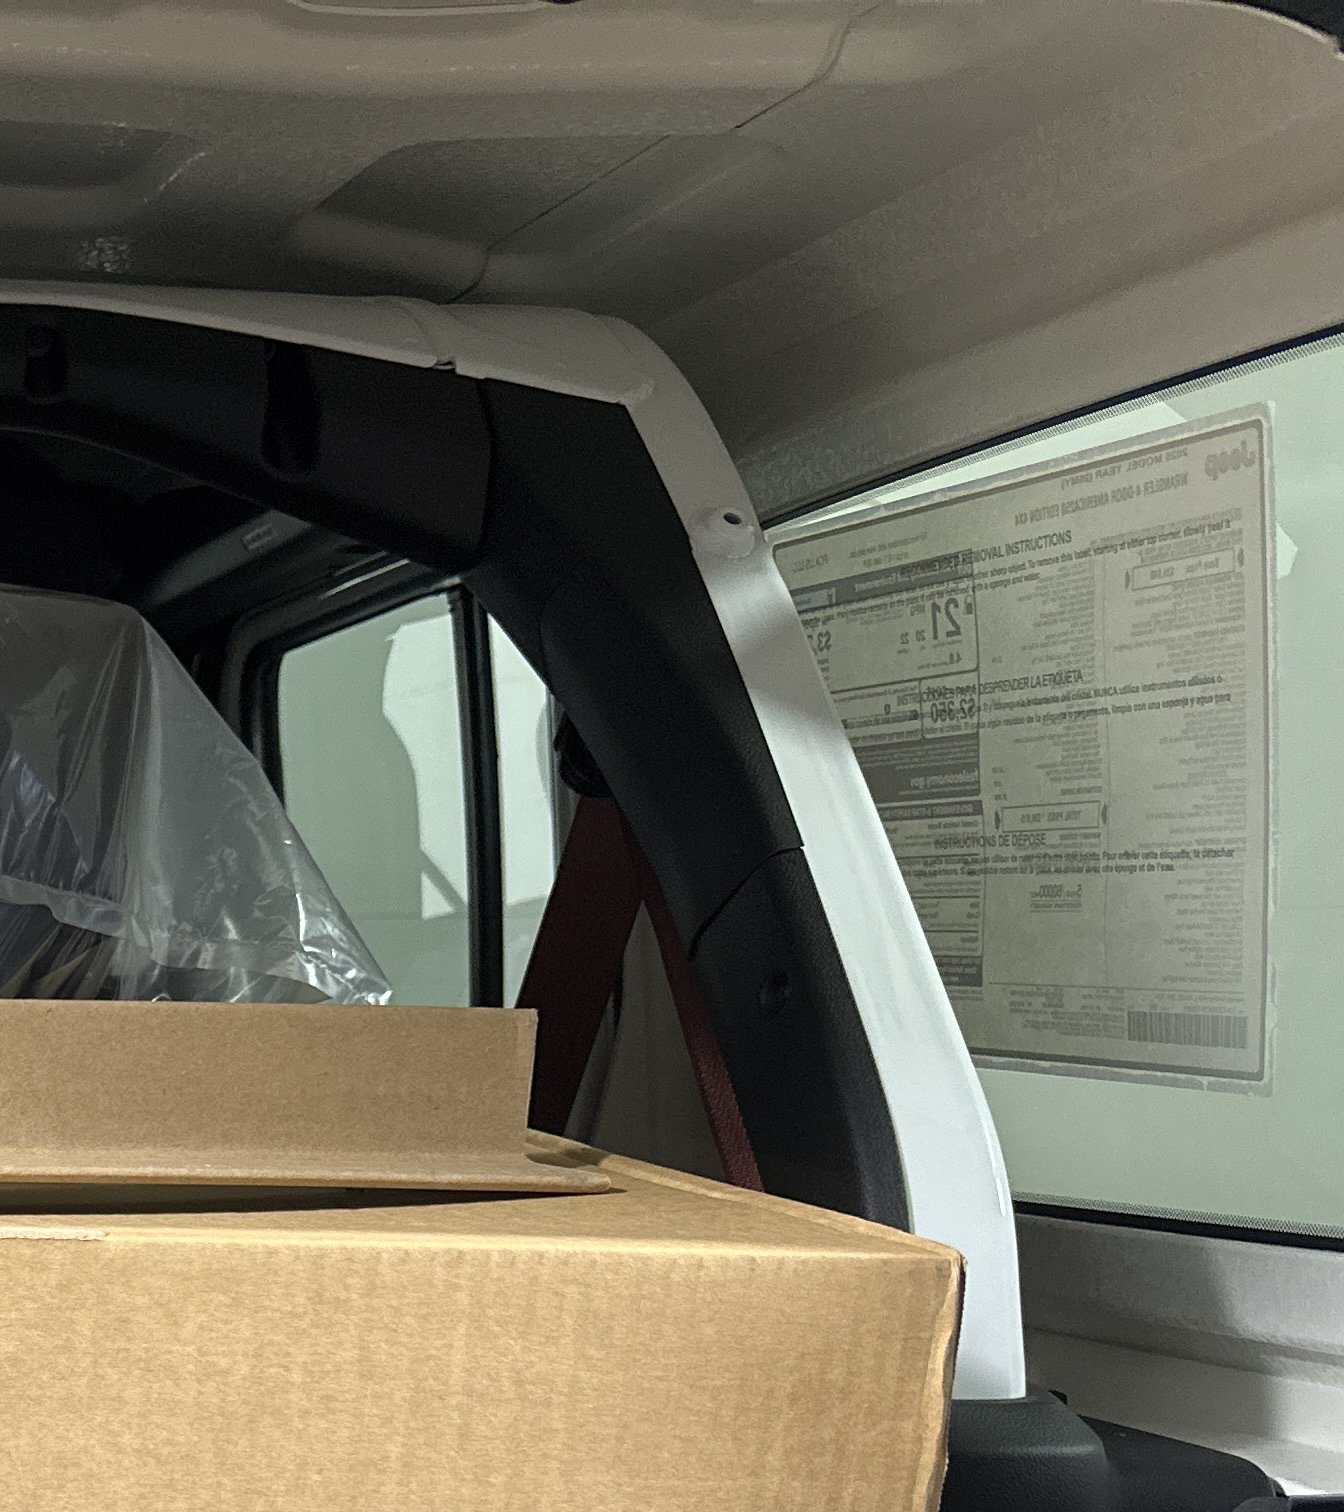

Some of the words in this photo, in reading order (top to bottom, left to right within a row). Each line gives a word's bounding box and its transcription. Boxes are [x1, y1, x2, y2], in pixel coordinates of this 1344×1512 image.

[962, 544, 1004, 565] REMOVAL
[1005, 530, 1072, 556] INSTRUCTIONS
[1036, 555, 1059, 567] remove
[979, 676, 1029, 695] DESPRENDER
[1030, 675, 1041, 688] LA
[1042, 669, 1083, 687] ETIQUETA
[1094, 686, 1118, 698] NUNCA
[934, 834, 997, 850] INSTRUCTIONS
[998, 834, 1010, 848] DE
